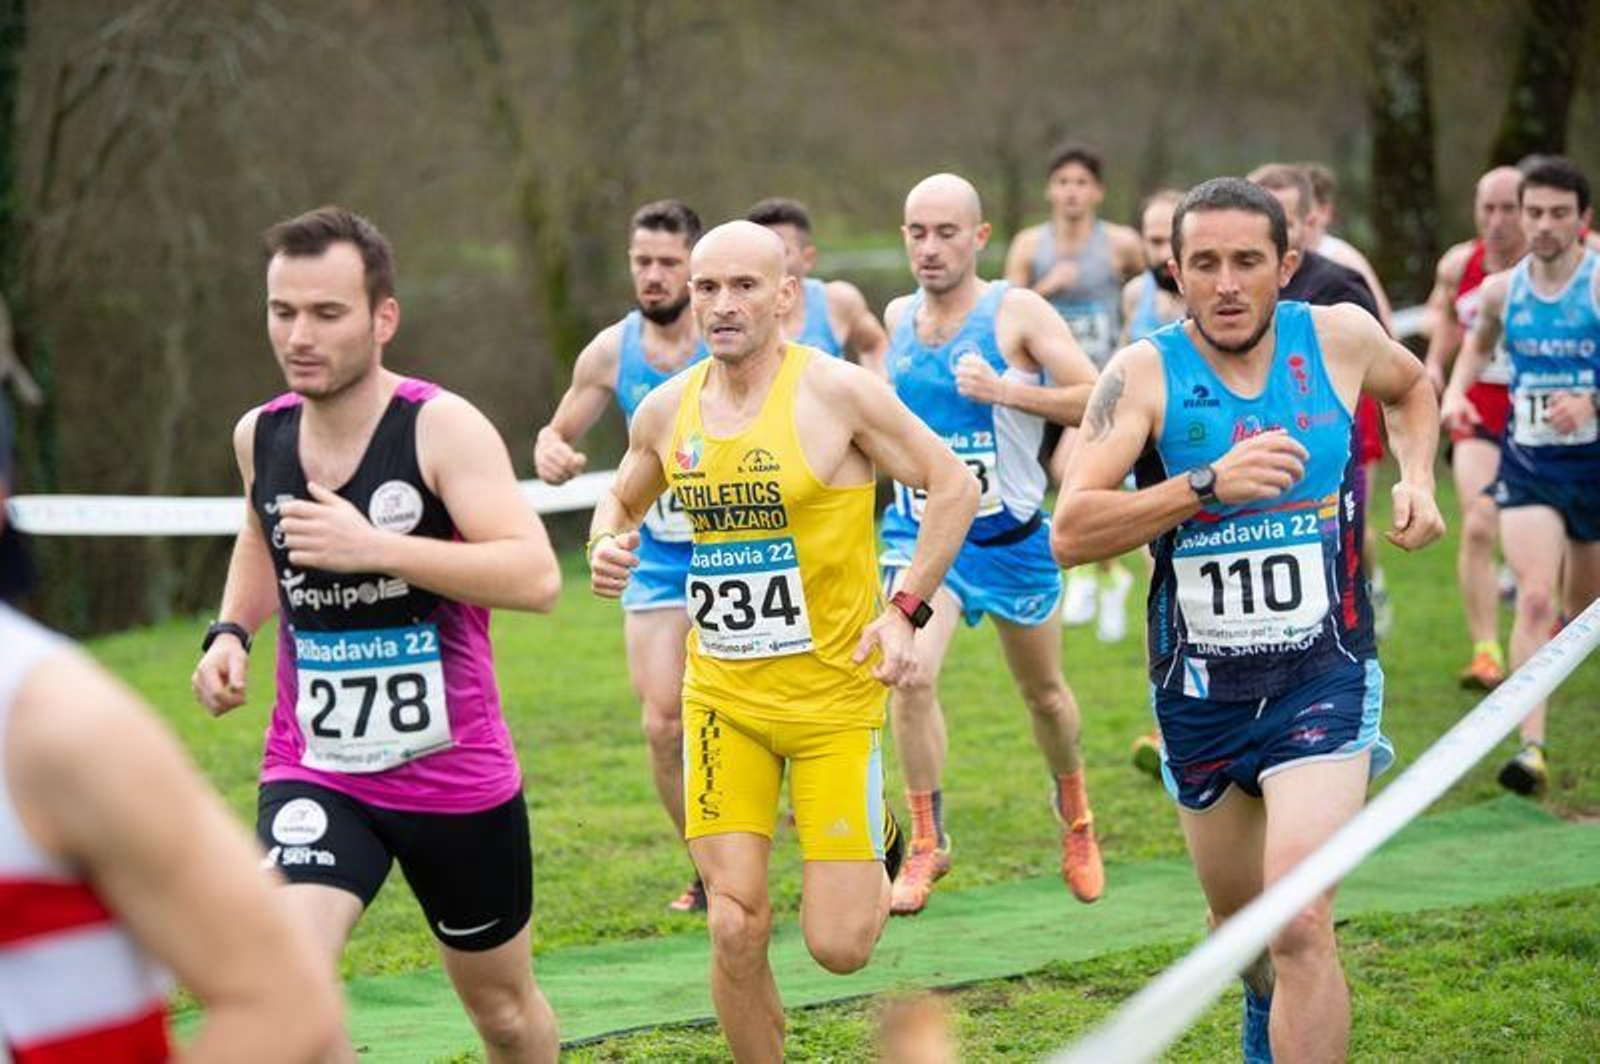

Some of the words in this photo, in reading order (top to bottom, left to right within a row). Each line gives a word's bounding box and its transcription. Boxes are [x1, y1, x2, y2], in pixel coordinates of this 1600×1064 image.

[1291, 513, 1319, 536] 22
[691, 545, 764, 569] badavia
[768, 542, 796, 562] 22
[1199, 554, 1303, 616] 110
[690, 575, 801, 632] 234
[295, 636, 399, 662] Ribadavia
[404, 630, 438, 655] 22
[1231, 637, 1315, 657] SANTIAG
[310, 672, 431, 739] 278
